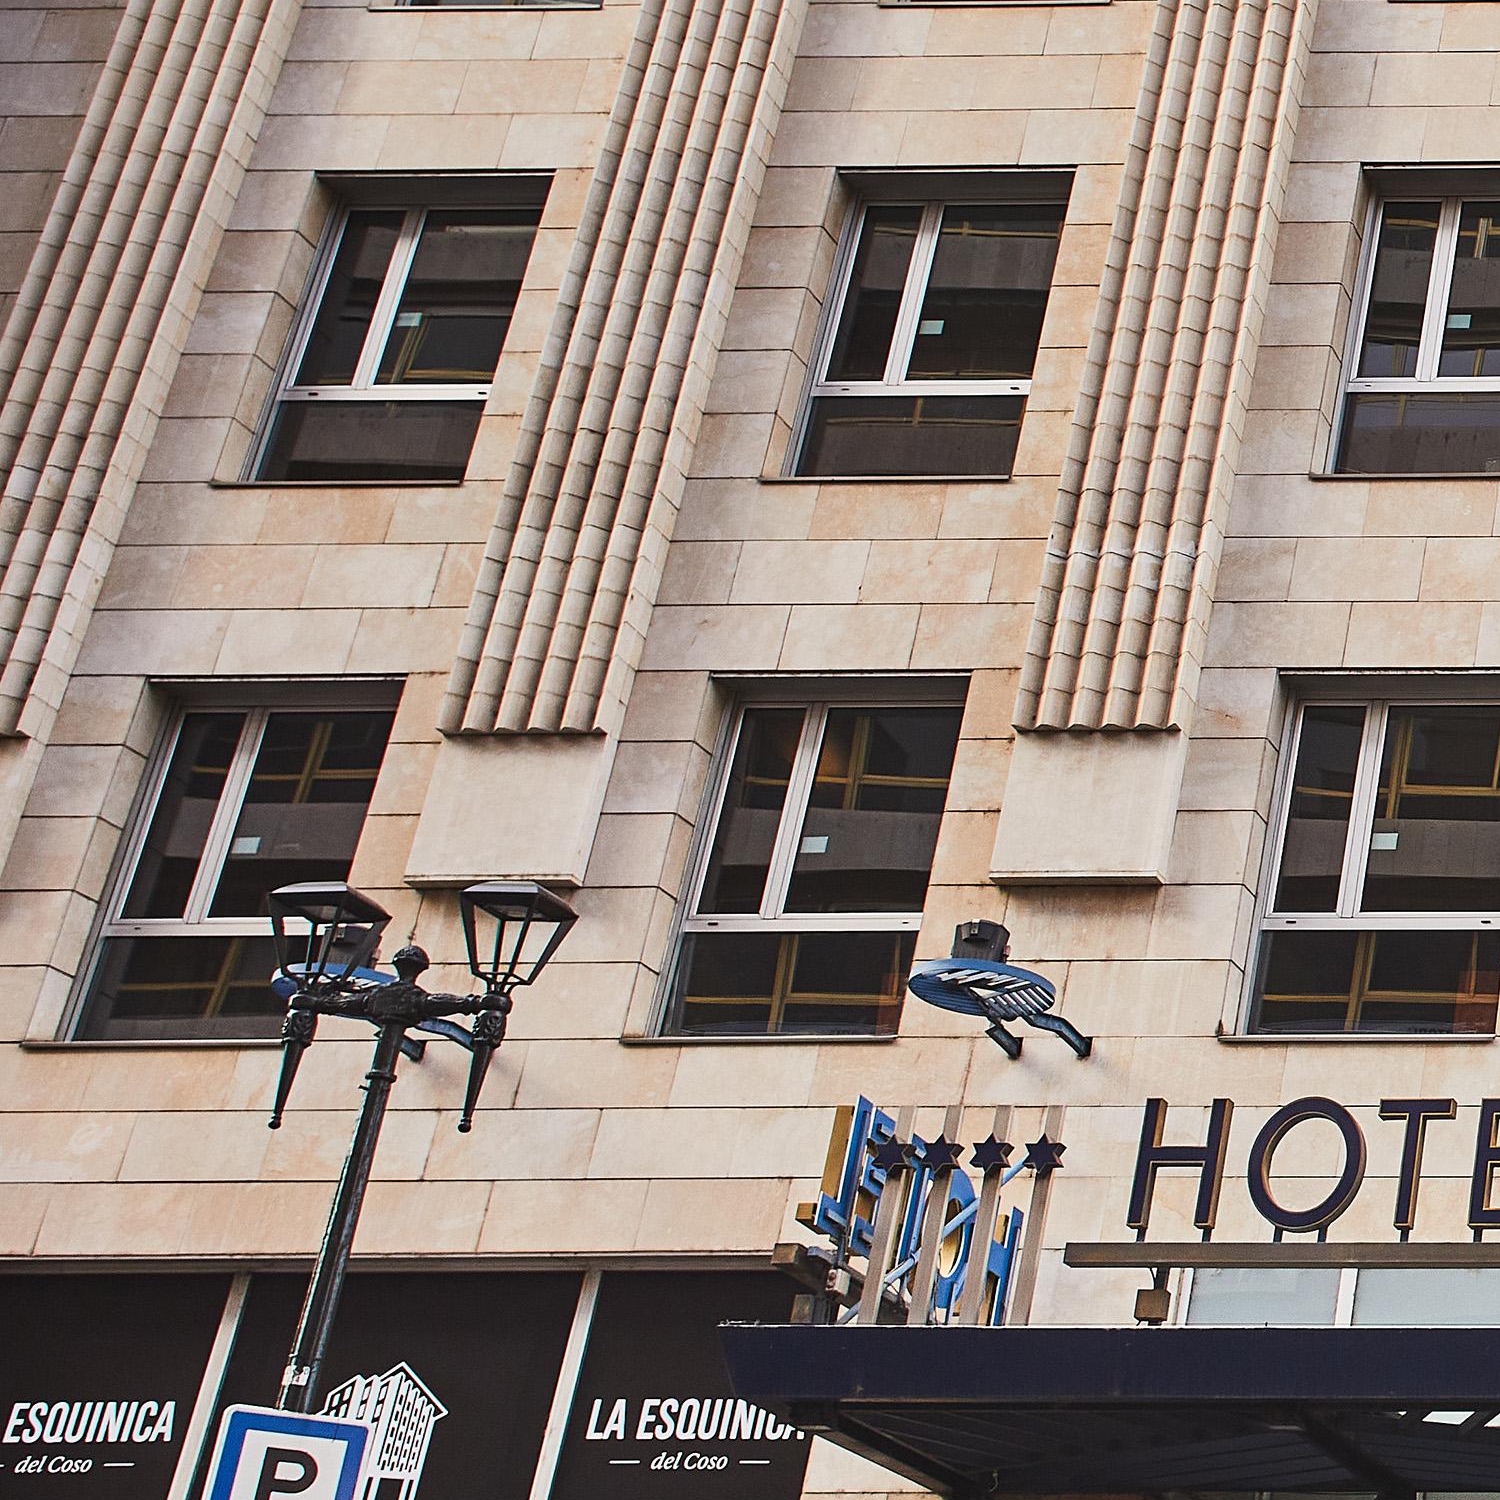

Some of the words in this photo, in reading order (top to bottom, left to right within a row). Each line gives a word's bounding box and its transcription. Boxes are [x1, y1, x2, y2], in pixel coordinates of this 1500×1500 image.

[2, 1400, 177, 1443] ESQUINICA
[585, 1398, 627, 1440] LA
[14, 1455, 48, 1474] del
[47, 1455, 93, 1474] Coso
[254, 1446, 318, 1500] P
[650, 1452, 683, 1470] del
[683, 1452, 729, 1470] Coso
